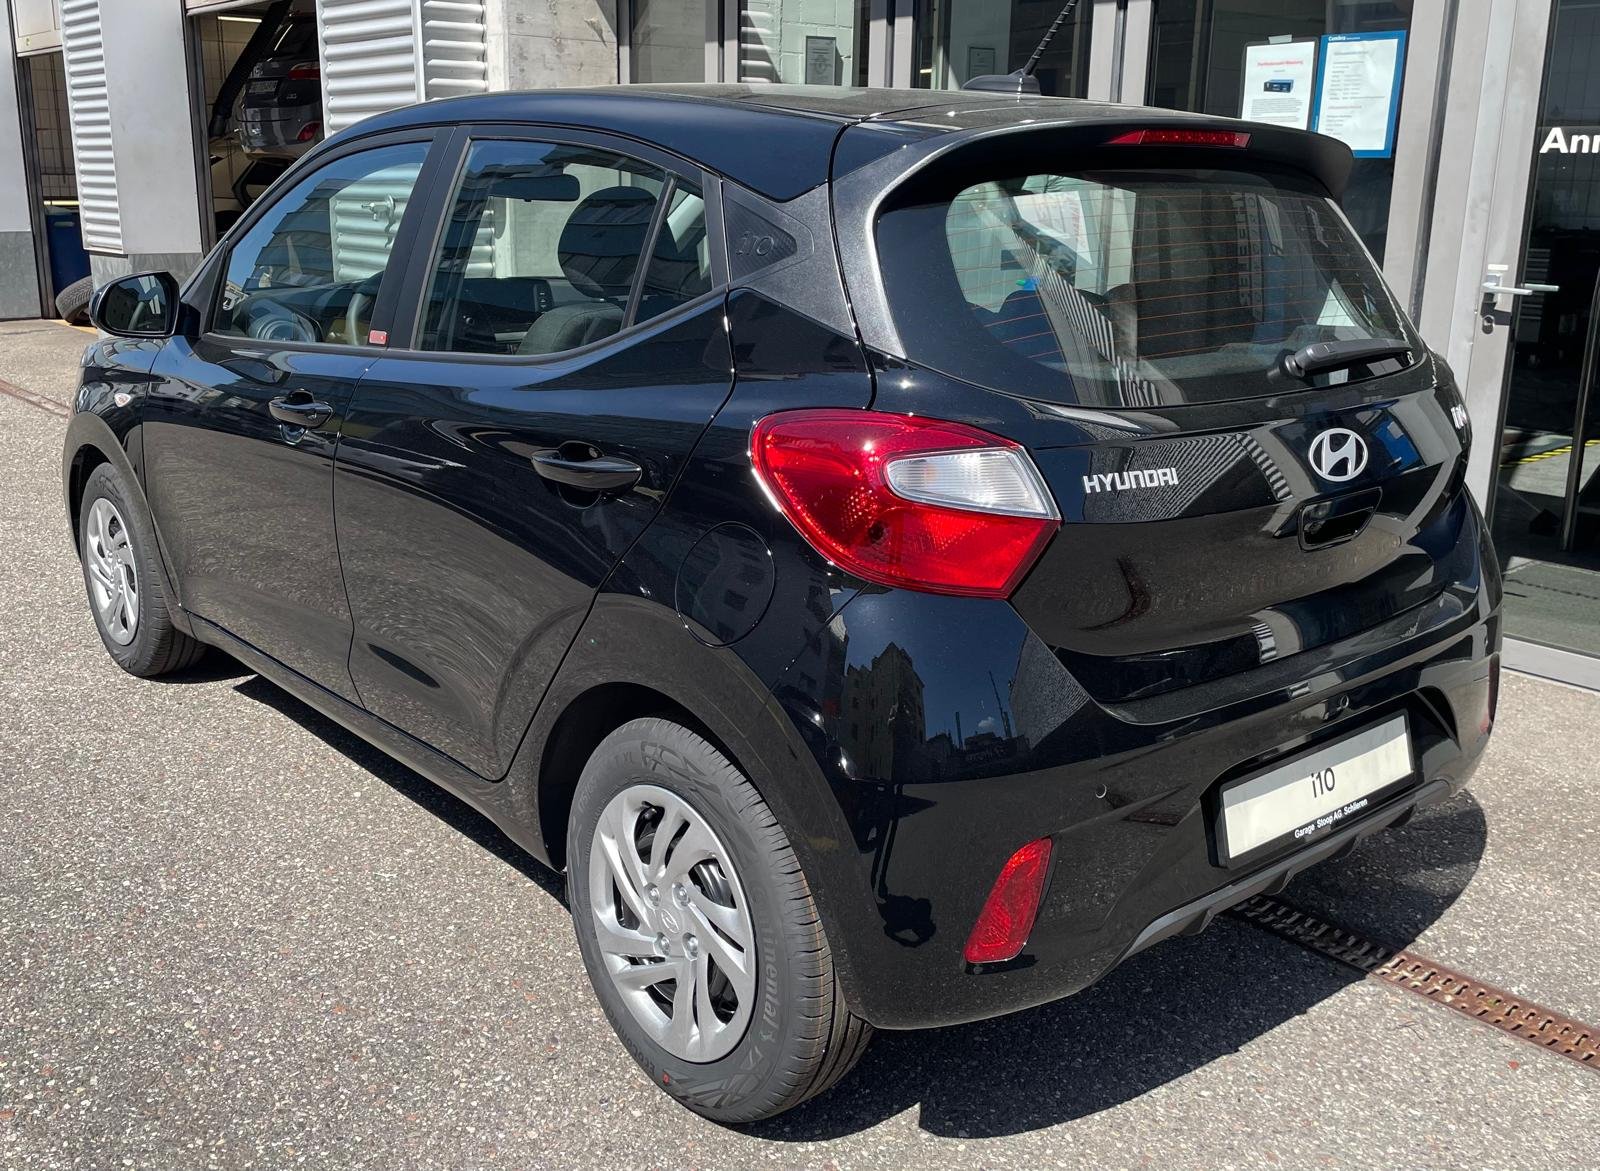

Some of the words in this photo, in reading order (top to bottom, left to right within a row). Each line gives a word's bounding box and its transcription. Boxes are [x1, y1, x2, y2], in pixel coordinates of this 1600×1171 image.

[1082, 467, 1179, 494] HYUNDAI
[1311, 767, 1336, 798] i10
[1294, 824, 1316, 839] Garage
[1316, 815, 1333, 829] Stoop
[1343, 798, 1368, 816] Schlieren
